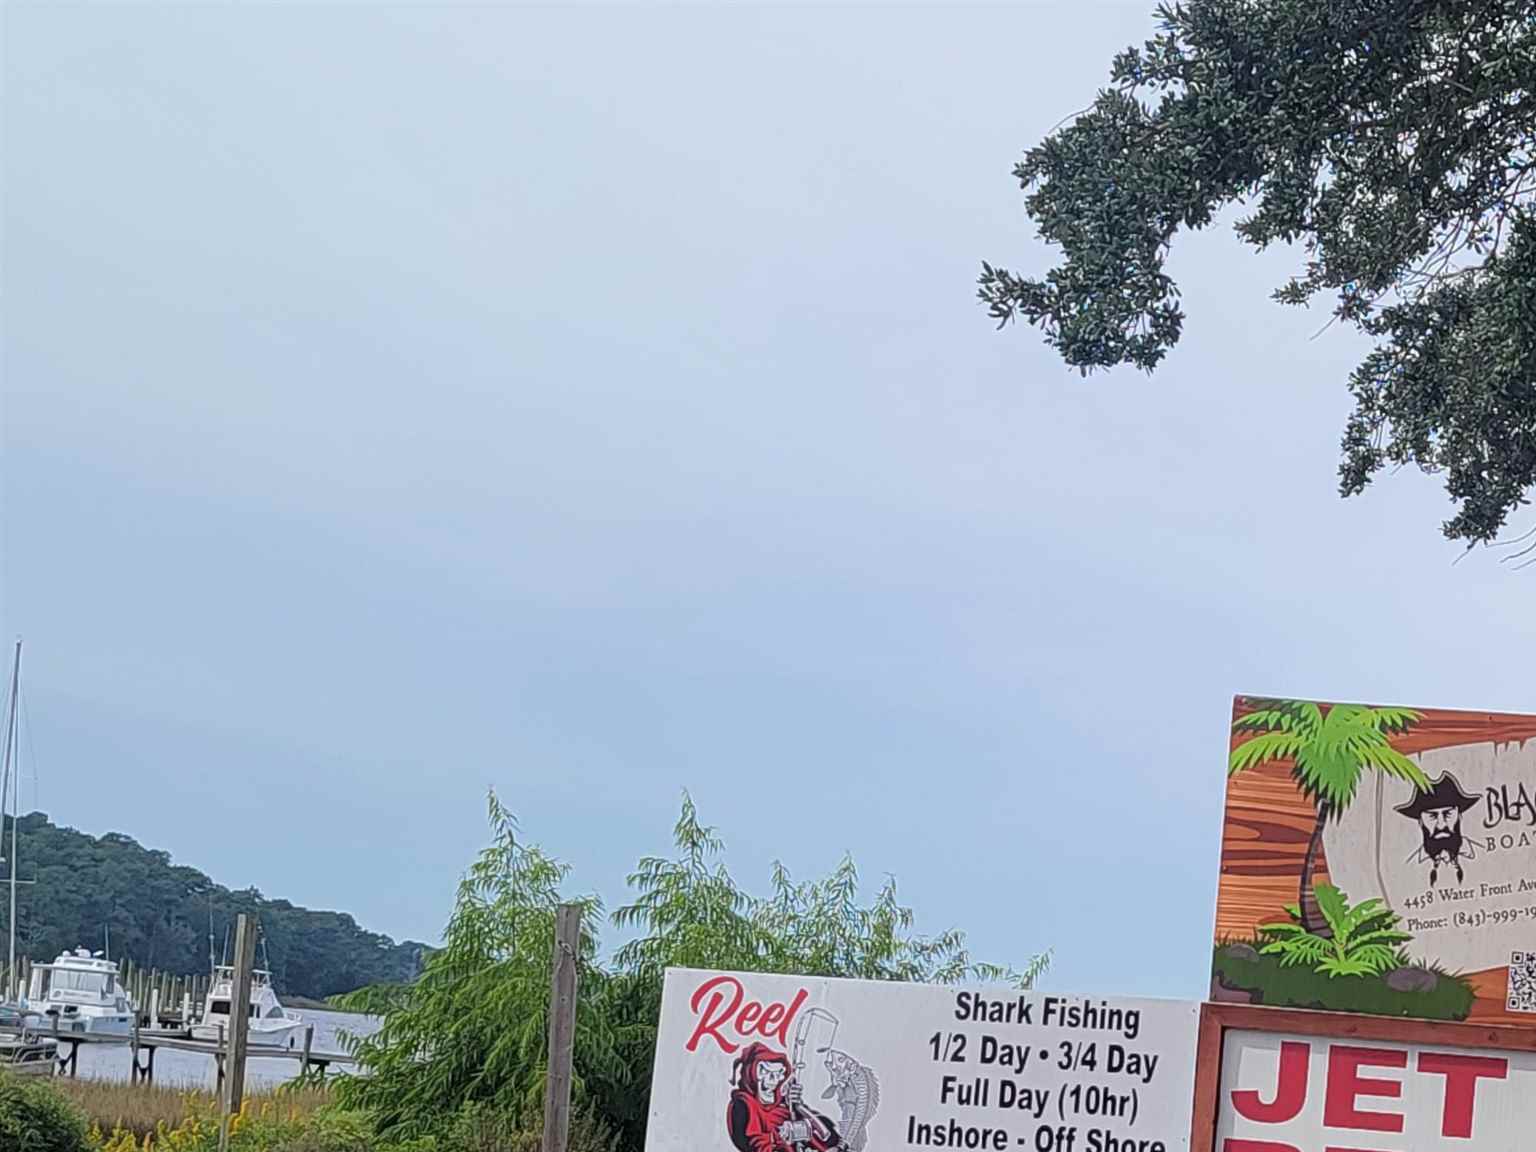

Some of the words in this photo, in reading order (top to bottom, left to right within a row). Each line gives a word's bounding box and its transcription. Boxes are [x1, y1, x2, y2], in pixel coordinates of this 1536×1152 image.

[1404, 892, 1433, 908] 4458
[1439, 888, 1474, 902] Water
[1481, 883, 1512, 897] Front
[1407, 915, 1448, 931] Phone:
[685, 974, 808, 1054] Reel
[954, 990, 1033, 1025] Shark
[1042, 997, 1141, 1039] Fishing
[928, 1032, 967, 1063] 1/2
[979, 1035, 1029, 1071] Day
[1057, 1041, 1097, 1072] 3/4
[1107, 1045, 1159, 1083] Day
[941, 1076, 991, 1108] Full
[999, 1079, 1050, 1119] Day
[1057, 1082, 1139, 1125] (10hr)
[1230, 1040, 1509, 1139] JET
[906, 1114, 1008, 1151] Inshore
